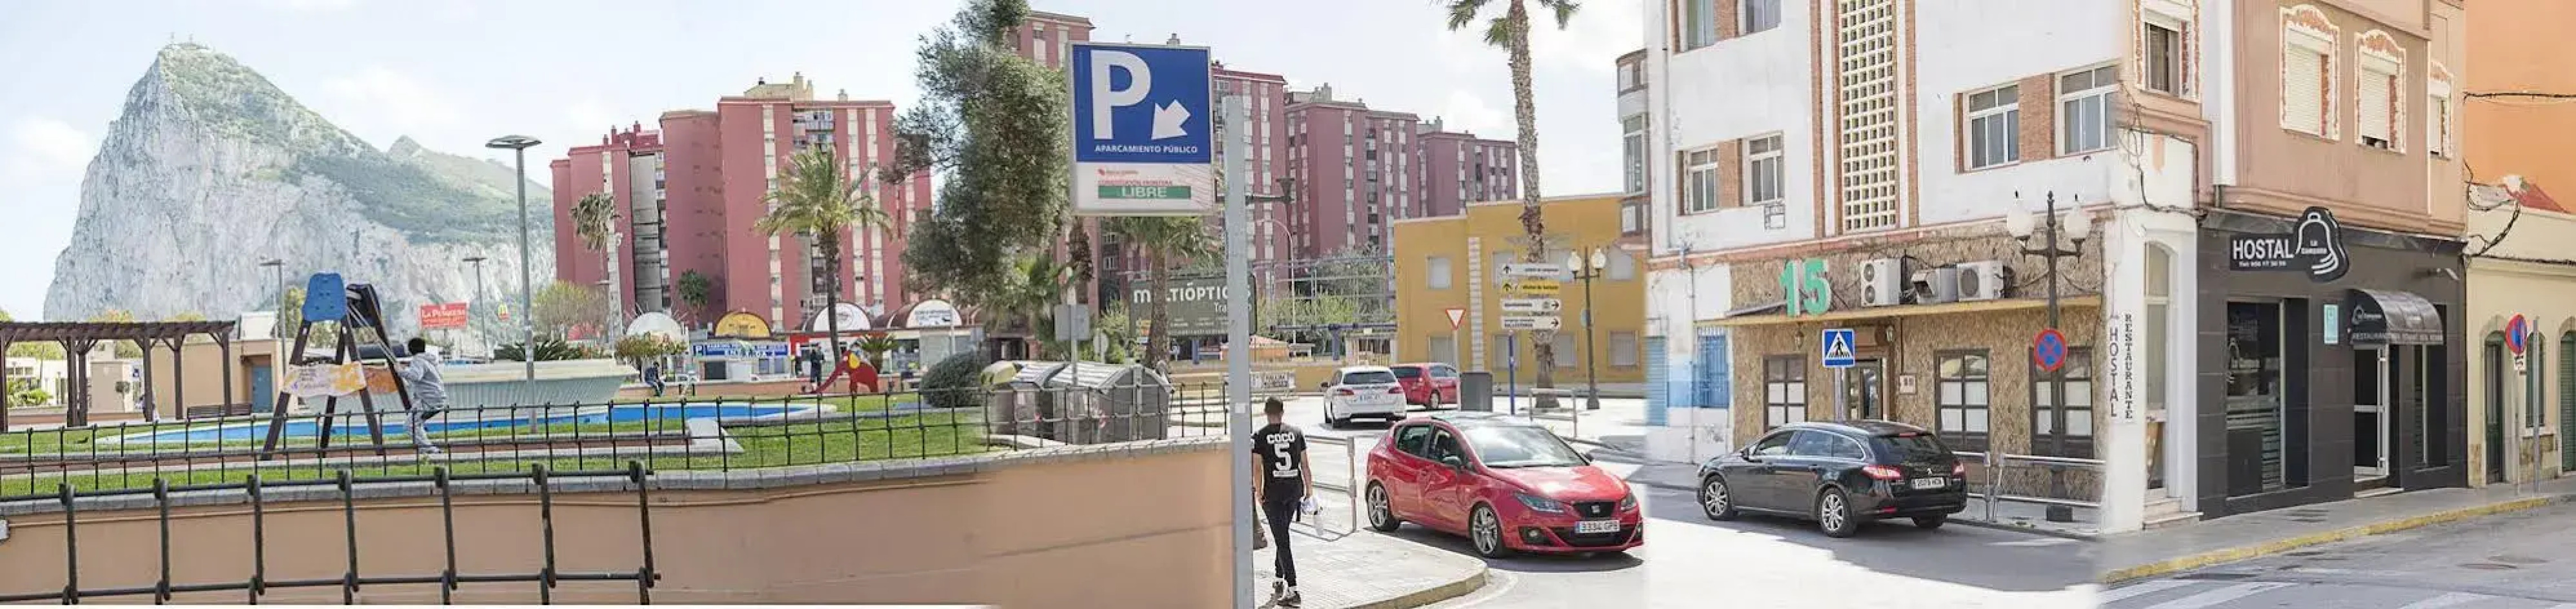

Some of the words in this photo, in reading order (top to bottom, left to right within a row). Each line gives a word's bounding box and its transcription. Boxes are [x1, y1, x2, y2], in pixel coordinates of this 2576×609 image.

[1091, 50, 1151, 140] P
[1094, 144, 1161, 153] APARCAMIENTO
[1163, 145, 1198, 154] PÚBLICO
[1122, 186, 1168, 197] LIBRE
[2232, 239, 2294, 259] HOSTAL
[1779, 257, 1832, 316] 15
[2110, 327, 2119, 417] HOSTAL
[1267, 433, 1295, 444] COCO
[1275, 443, 1292, 470] 5
